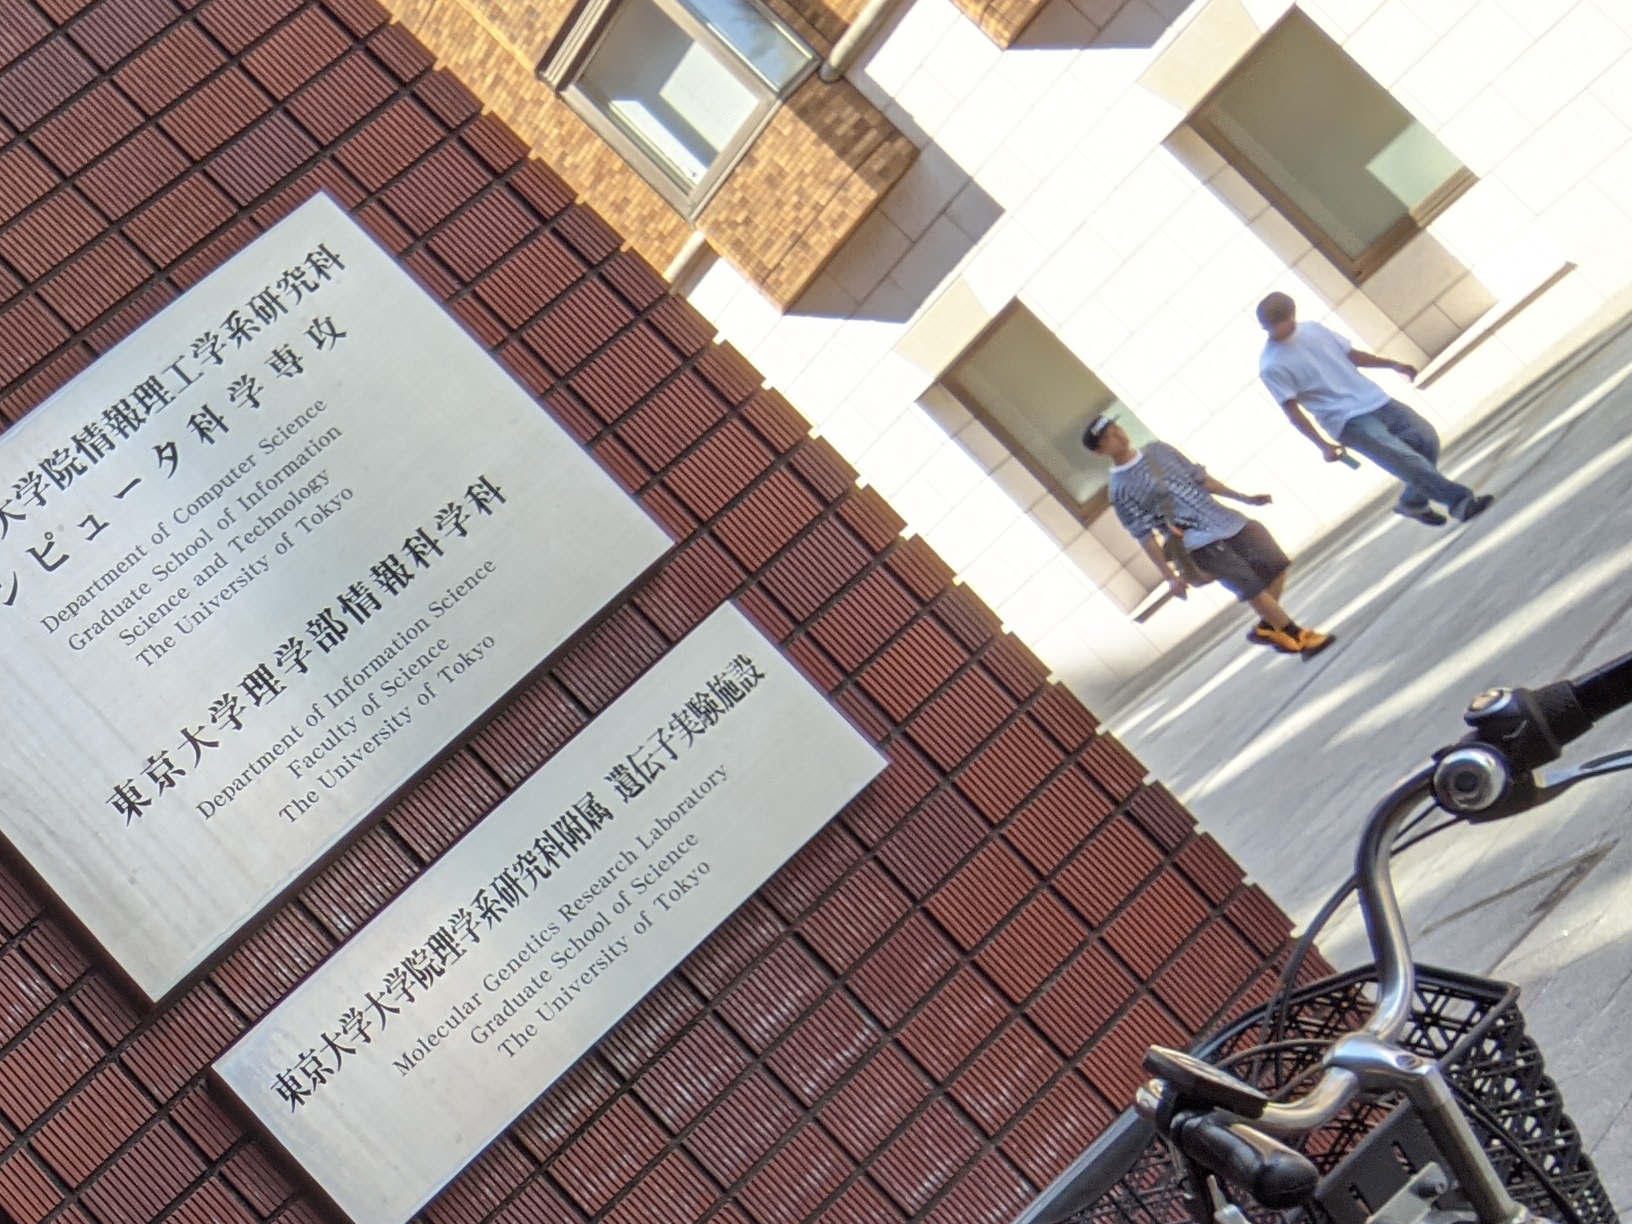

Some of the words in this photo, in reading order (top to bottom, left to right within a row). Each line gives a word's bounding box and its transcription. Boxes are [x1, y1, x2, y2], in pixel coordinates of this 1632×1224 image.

[40, 543, 147, 634] Department
[151, 522, 171, 546] of
[173, 453, 257, 526] Computer
[258, 398, 328, 455] Science
[68, 580, 152, 651] Graduate
[152, 528, 214, 582] School
[217, 507, 237, 531] of
[236, 424, 343, 512] Information
[119, 587, 191, 647] Science
[193, 552, 229, 588] and
[228, 469, 331, 555] Technology
[136, 634, 176, 668] The
[174, 553, 270, 636] University
[274, 531, 295, 555] of
[295, 486, 354, 535] Tokyo
[105, 475, 508, 826] 東京大学理学部情報科学科
[196, 725, 304, 820] Department
[305, 703, 326, 728] of
[323, 616, 431, 710] Information
[428, 558, 497, 619] Science
[278, 789, 320, 826] The
[316, 705, 413, 789] University
[417, 682, 438, 707] of
[436, 634, 496, 685] Tokyo
[286, 715, 358, 779] Faculty
[361, 692, 383, 717] of
[379, 637, 450, 698] Science
[270, 791, 614, 1114] 東京大学大学院理学系研究科附属
[603, 654, 766, 804] 遺伝子実験施設
[392, 991, 482, 1077] Molecular
[483, 920, 561, 993] Genetics
[557, 850, 638, 923] Research
[635, 764, 730, 849] Laboratory
[470, 971, 553, 1045] Graduate
[550, 914, 612, 971] School
[613, 890, 633, 916] of
[631, 831, 699, 896] Science
[497, 1020, 538, 1058] The
[543, 933, 630, 1023] University
[633, 911, 655, 936] of
[653, 860, 711, 913] Tokyo
